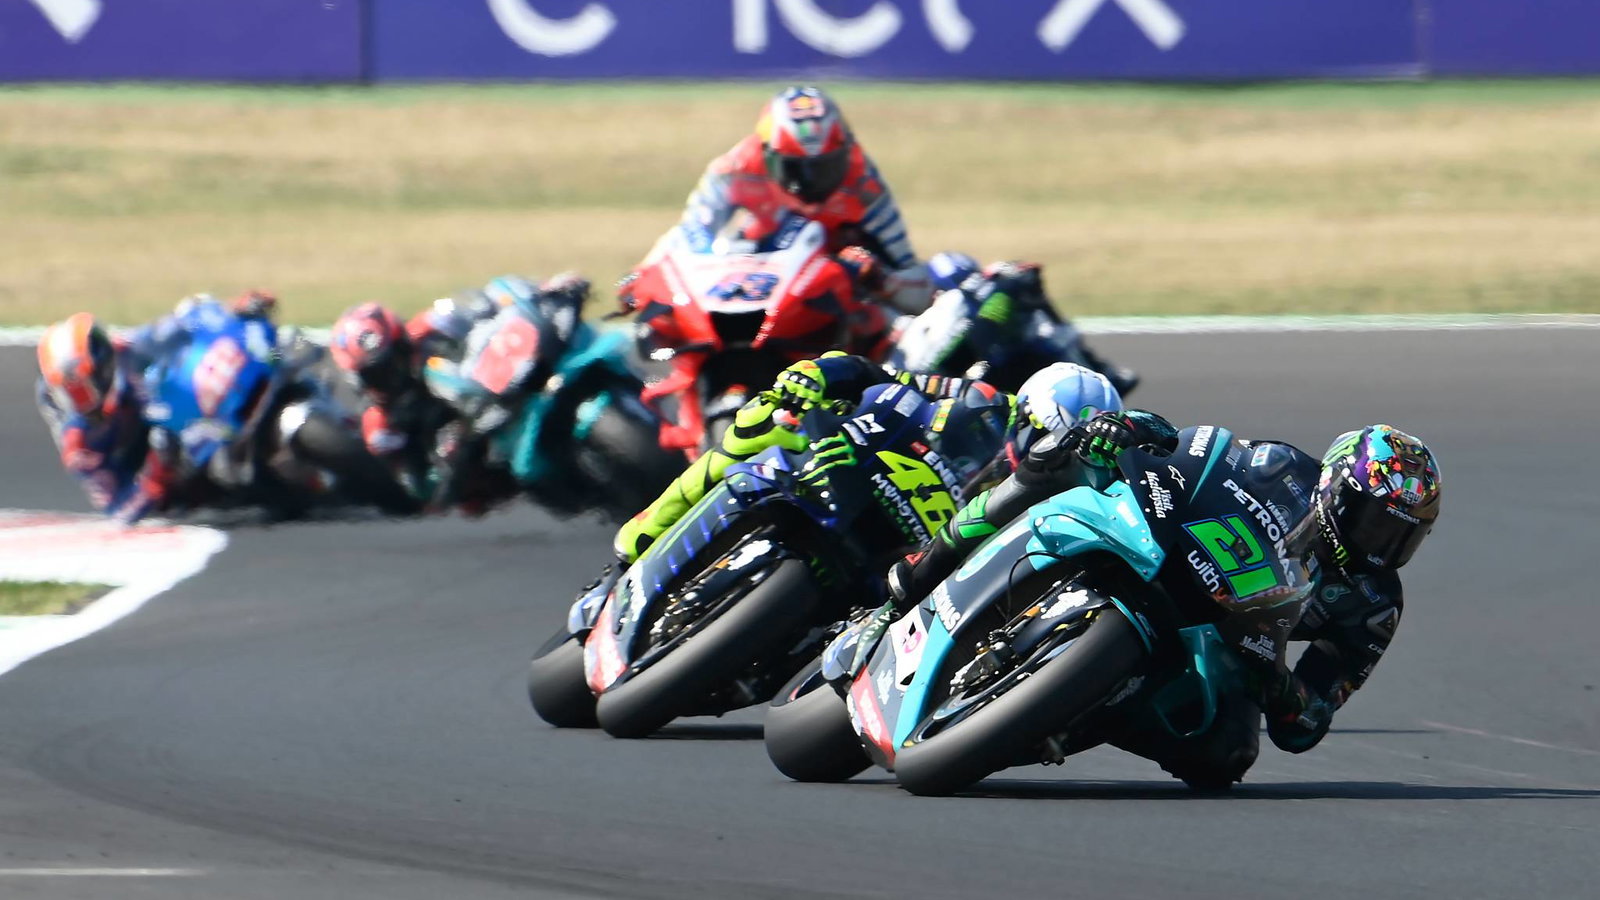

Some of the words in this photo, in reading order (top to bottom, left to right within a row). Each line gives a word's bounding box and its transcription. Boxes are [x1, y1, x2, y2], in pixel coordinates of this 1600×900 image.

[874, 450, 958, 538] 46
[1144, 470, 1167, 518] Malaysia
[1222, 478, 1296, 588] PETRONAS
[1184, 515, 1279, 600] 21
